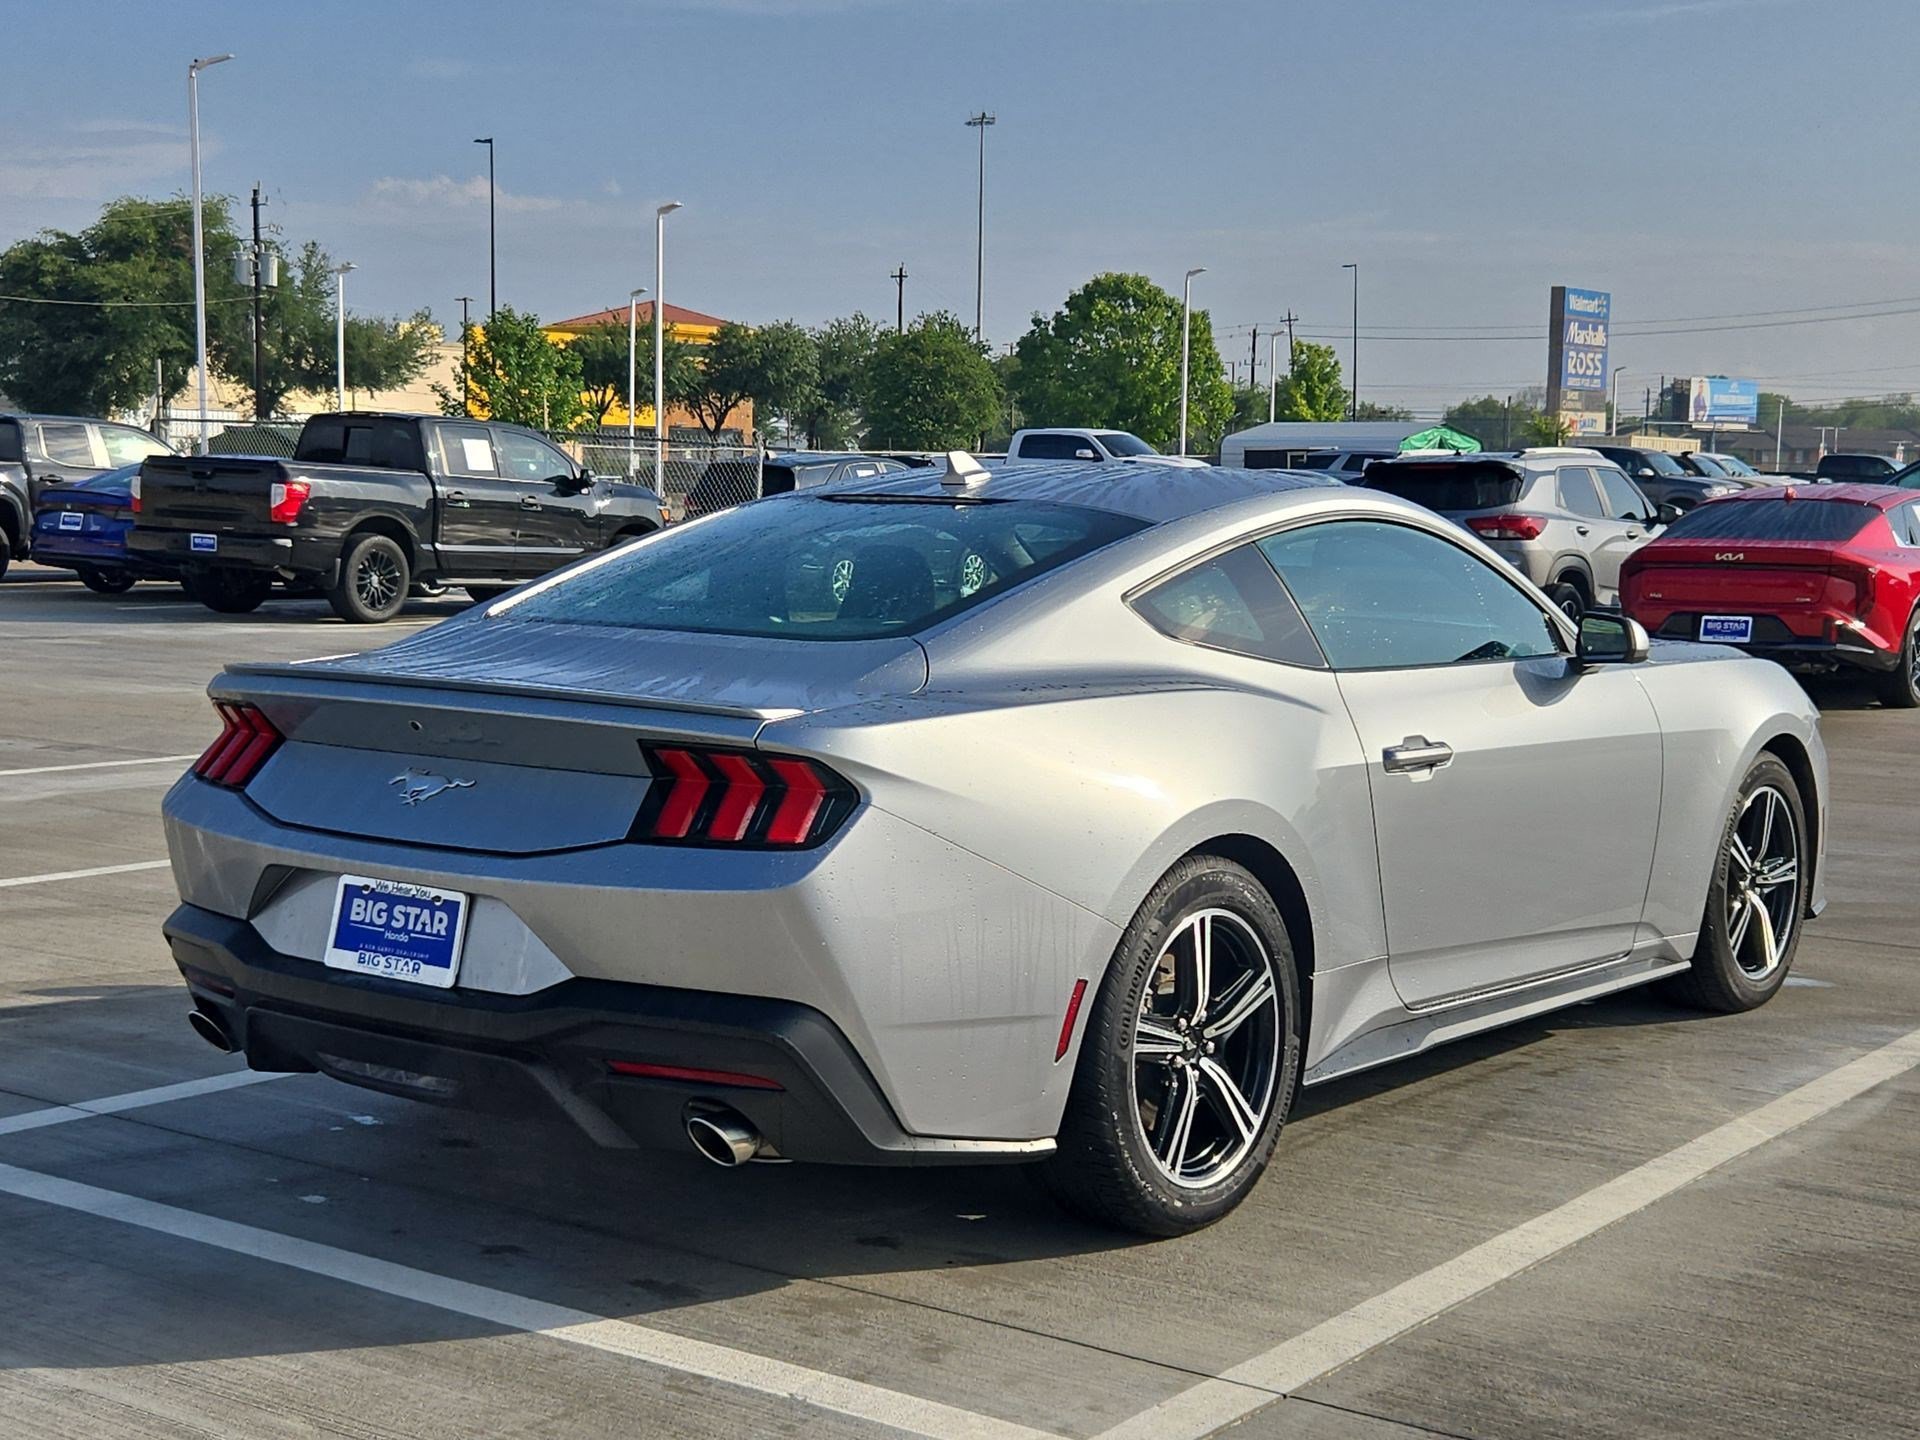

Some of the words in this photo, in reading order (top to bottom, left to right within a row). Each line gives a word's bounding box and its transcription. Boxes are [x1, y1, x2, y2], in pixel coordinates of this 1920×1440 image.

[1569, 294, 1598, 313] Walmart
[1565, 321, 1607, 347] Marshalls
[1567, 350, 1603, 376] ROSS
[1722, 621, 1746, 631] STAR
[375, 880, 389, 892] We
[391, 882, 412, 895] Hear
[414, 886, 431, 899] You
[349, 897, 388, 925] BIG
[391, 904, 449, 936] STAR
[384, 930, 410, 943] Honda
[357, 951, 381, 967] BIG
[383, 957, 421, 975] STAR
[1119, 938, 1154, 1050] Continental
